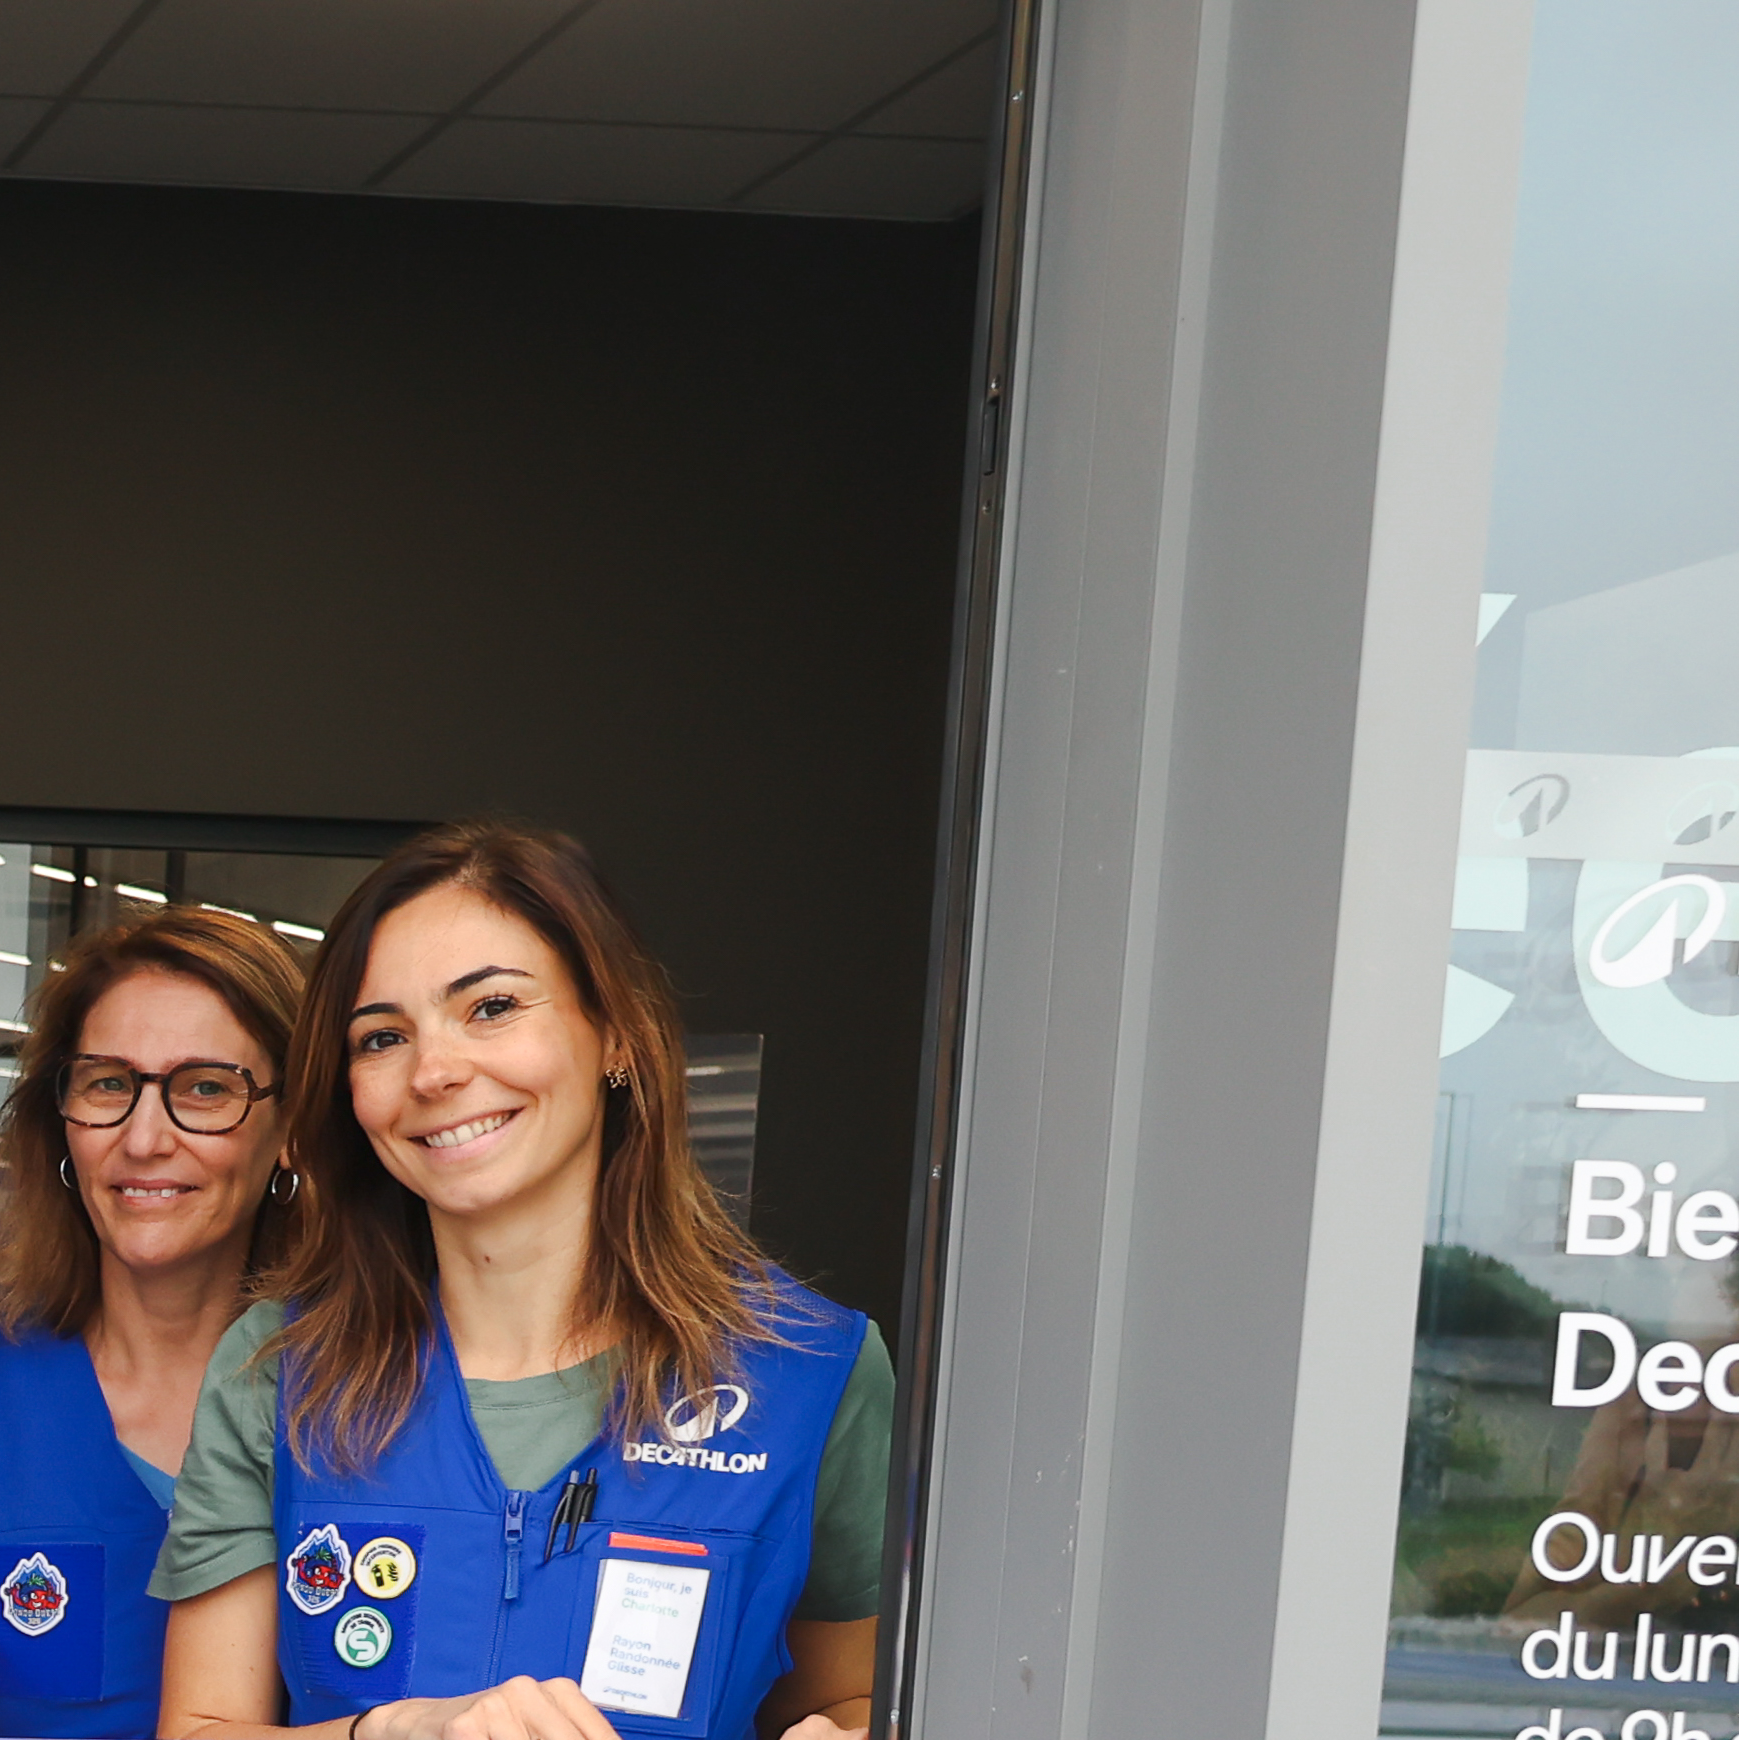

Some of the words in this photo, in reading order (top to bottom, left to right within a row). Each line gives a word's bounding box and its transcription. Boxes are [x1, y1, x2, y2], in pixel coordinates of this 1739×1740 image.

[1565, 1160, 1739, 1261] Bie
[623, 1442, 768, 1474] DECATHLON
[1531, 1512, 1739, 1586] Ouve
[624, 1587, 649, 1598] suis
[626, 1572, 677, 1594] Bonjour,
[679, 1582, 692, 1595] je
[621, 1597, 679, 1618] Charlotte
[612, 1634, 652, 1651] Rayon
[1521, 1611, 1618, 1680] du
[1632, 1613, 1739, 1683] lun
[607, 1660, 646, 1676] Glisse
[610, 1647, 681, 1670] Randonnée
